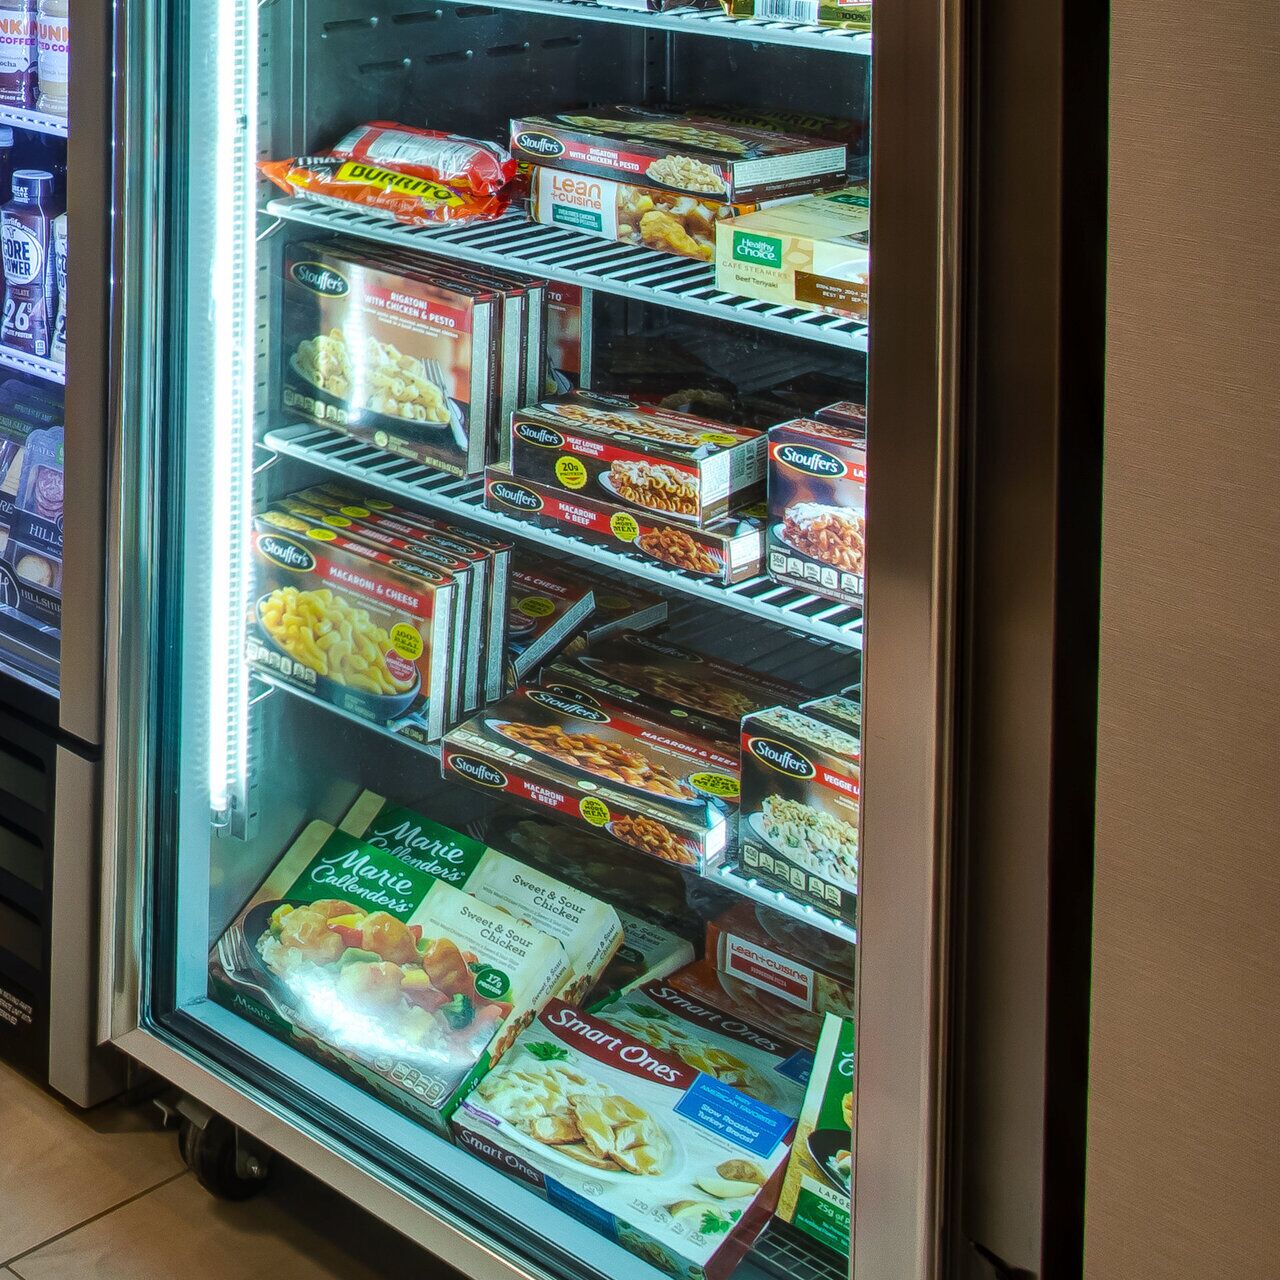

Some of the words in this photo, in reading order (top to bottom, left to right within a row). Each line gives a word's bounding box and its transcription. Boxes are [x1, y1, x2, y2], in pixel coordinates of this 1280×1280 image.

[841, 12, 866, 22] 100%
[0, 36, 36, 46] COFFEE
[520, 133, 566, 155] Stouffer's
[589, 147, 619, 160] RIGATONI
[569, 150, 586, 161] WITH
[586, 153, 612, 166] CHICKEN
[619, 161, 640, 172] PESTO
[348, 164, 453, 201] BURRITO
[552, 175, 602, 200] Lean
[736, 244, 776, 261] Choice
[741, 237, 775, 254] Healthy
[298, 266, 344, 293] Stouffer's
[736, 274, 751, 285] Beef
[751, 277, 778, 289] Teriyaki
[391, 291, 428, 310] RIGATONI
[385, 299, 420, 319] CHICKEN
[421, 309, 428, 320] &
[429, 312, 455, 328] PESTO
[520, 424, 566, 448] Stouffer's
[567, 436, 582, 446] MEAT
[582, 438, 604, 452] LOVERS
[561, 461, 579, 472] 20g
[782, 446, 838, 474] Stouffer's
[494, 485, 539, 509] Stouffer's
[558, 502, 596, 521] MACARONI
[571, 514, 590, 526] BEEF
[262, 537, 309, 568] Stouffer's
[328, 565, 375, 592] MACARONI
[376, 584, 383, 594] &
[385, 589, 420, 609] CHEESE
[536, 691, 600, 722] Stouffer's
[641, 730, 698, 754] MACARONI
[710, 752, 738, 768] BEEF
[757, 740, 808, 774] Stouffer's
[455, 756, 500, 784] Stouffer's
[824, 772, 853, 791] VEGGIE
[523, 781, 565, 803] MACARONI
[530, 791, 537, 799] &
[538, 792, 558, 807] BEEF
[373, 820, 467, 865] Marie
[322, 849, 413, 896] Marie
[311, 864, 411, 914] Callender's
[512, 874, 547, 896] Sweet
[547, 891, 557, 901] &
[558, 894, 586, 915] Sour
[533, 896, 580, 924] Chicken
[460, 906, 494, 930] Sweet
[494, 922, 504, 934] &
[505, 929, 534, 949] Sour
[479, 928, 527, 958] Chicken
[730, 942, 756, 960] Lean
[477, 980, 503, 996] PROTEIN
[485, 972, 503, 989] 17g
[648, 985, 723, 1023] Smart
[719, 1019, 777, 1053] Ones
[547, 1008, 621, 1056] Smart
[618, 1044, 685, 1084] Ones
[697, 1110, 724, 1131] Turkey
[725, 1123, 755, 1144] Breast
[700, 1102, 723, 1119] Slow
[722, 1113, 760, 1139] Roasted
[459, 1129, 505, 1161] Smart
[504, 1153, 541, 1182] Ones
[817, 1201, 835, 1218] 25g
